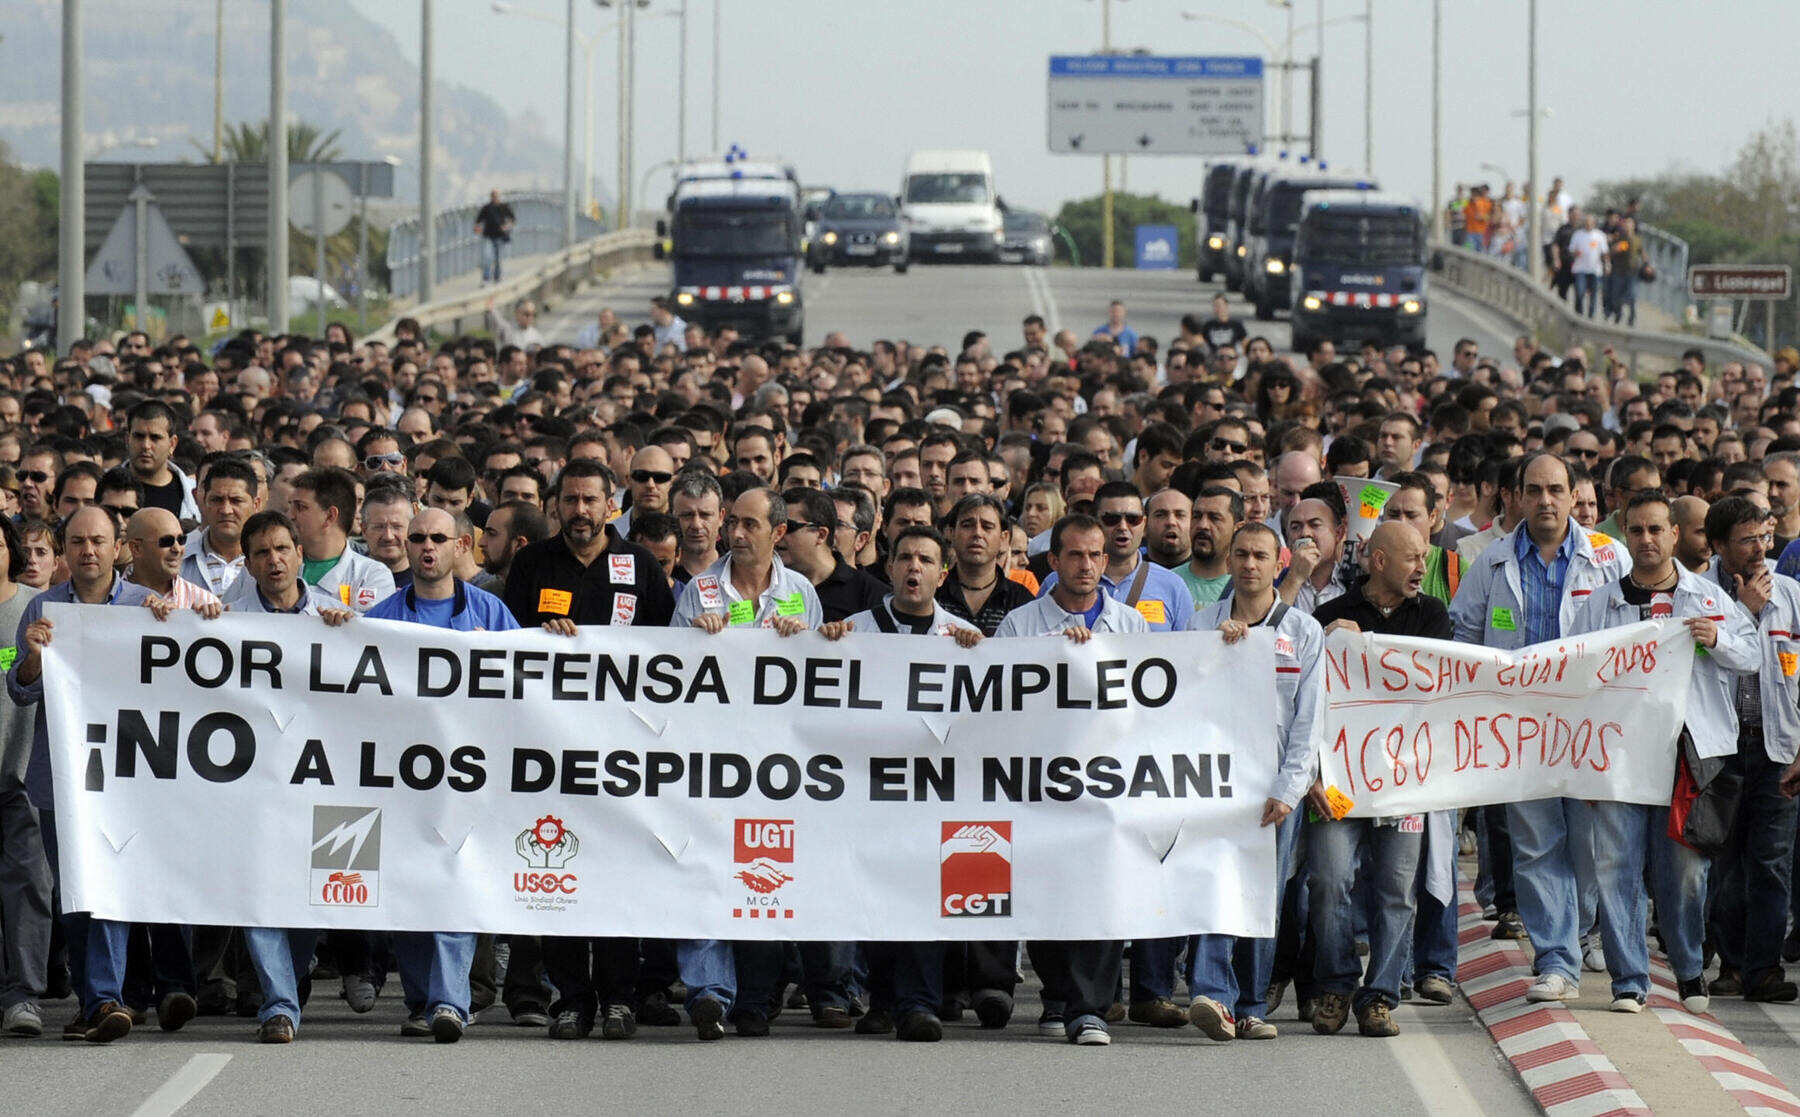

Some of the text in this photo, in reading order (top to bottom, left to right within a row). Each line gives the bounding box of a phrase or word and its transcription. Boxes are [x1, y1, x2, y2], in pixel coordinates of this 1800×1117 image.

[140, 635, 1178, 714] POR LA DEFENSA DEL EMPLEO
[1325, 646, 1482, 695] NISSAN
[87, 709, 1233, 803] ¡NO A LOS DESPIDOS EN NISSAN!
[1332, 721, 1434, 796] 1680
[744, 823, 795, 849] UGT
[322, 883, 369, 904] CCOO
[514, 872, 578, 894] USOC
[944, 893, 1009, 914] CGT
